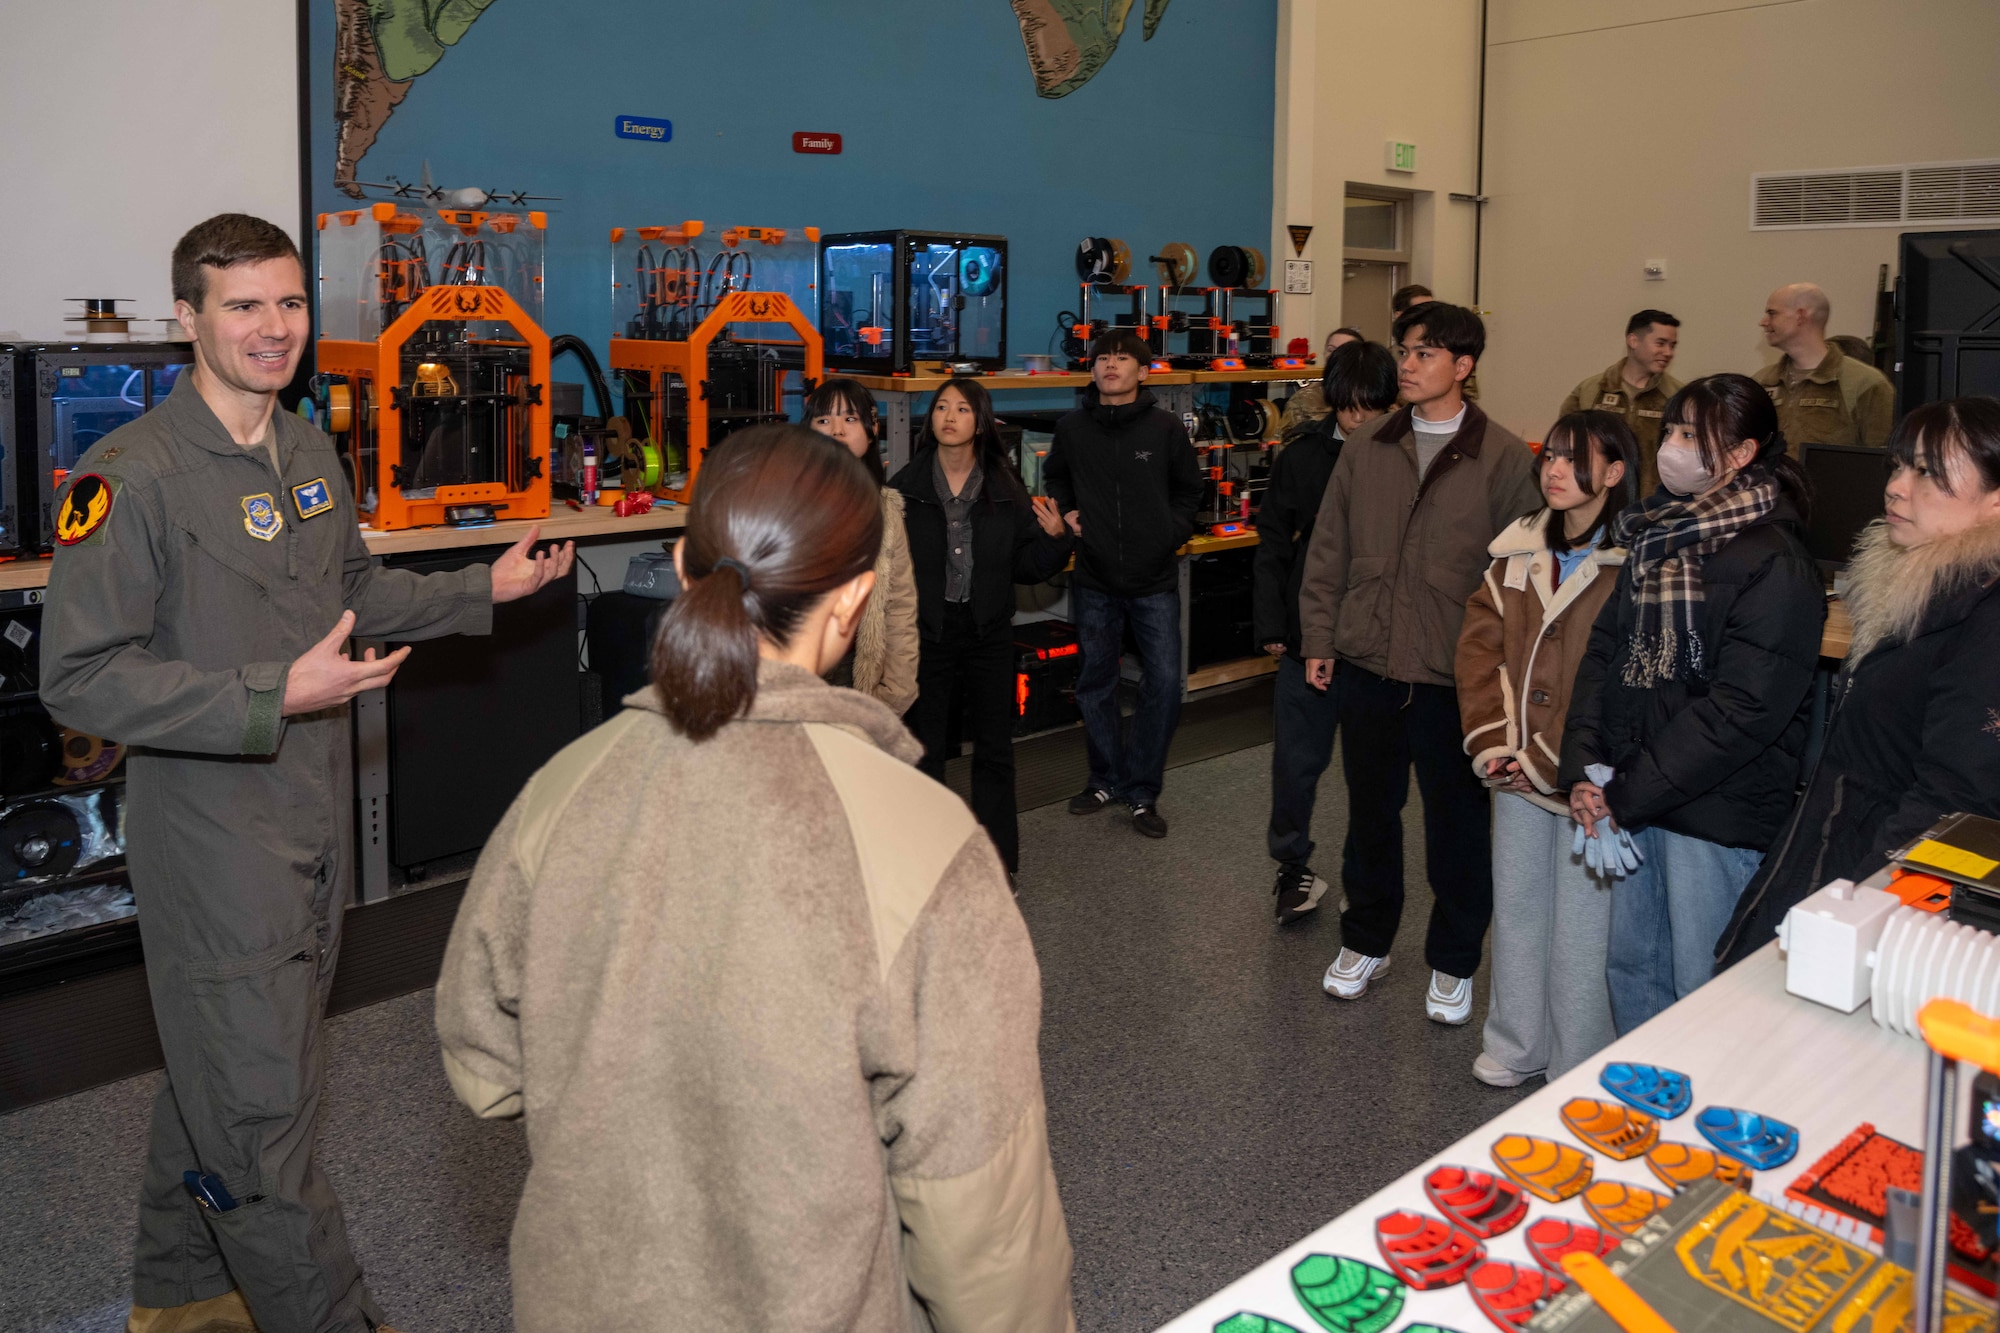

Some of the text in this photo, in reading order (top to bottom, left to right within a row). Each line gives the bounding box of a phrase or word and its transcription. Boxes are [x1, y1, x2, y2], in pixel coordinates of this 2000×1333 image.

[622, 120, 666, 139] Energy
[802, 137, 834, 151] Family
[1395, 142, 1416, 170] EXIT
